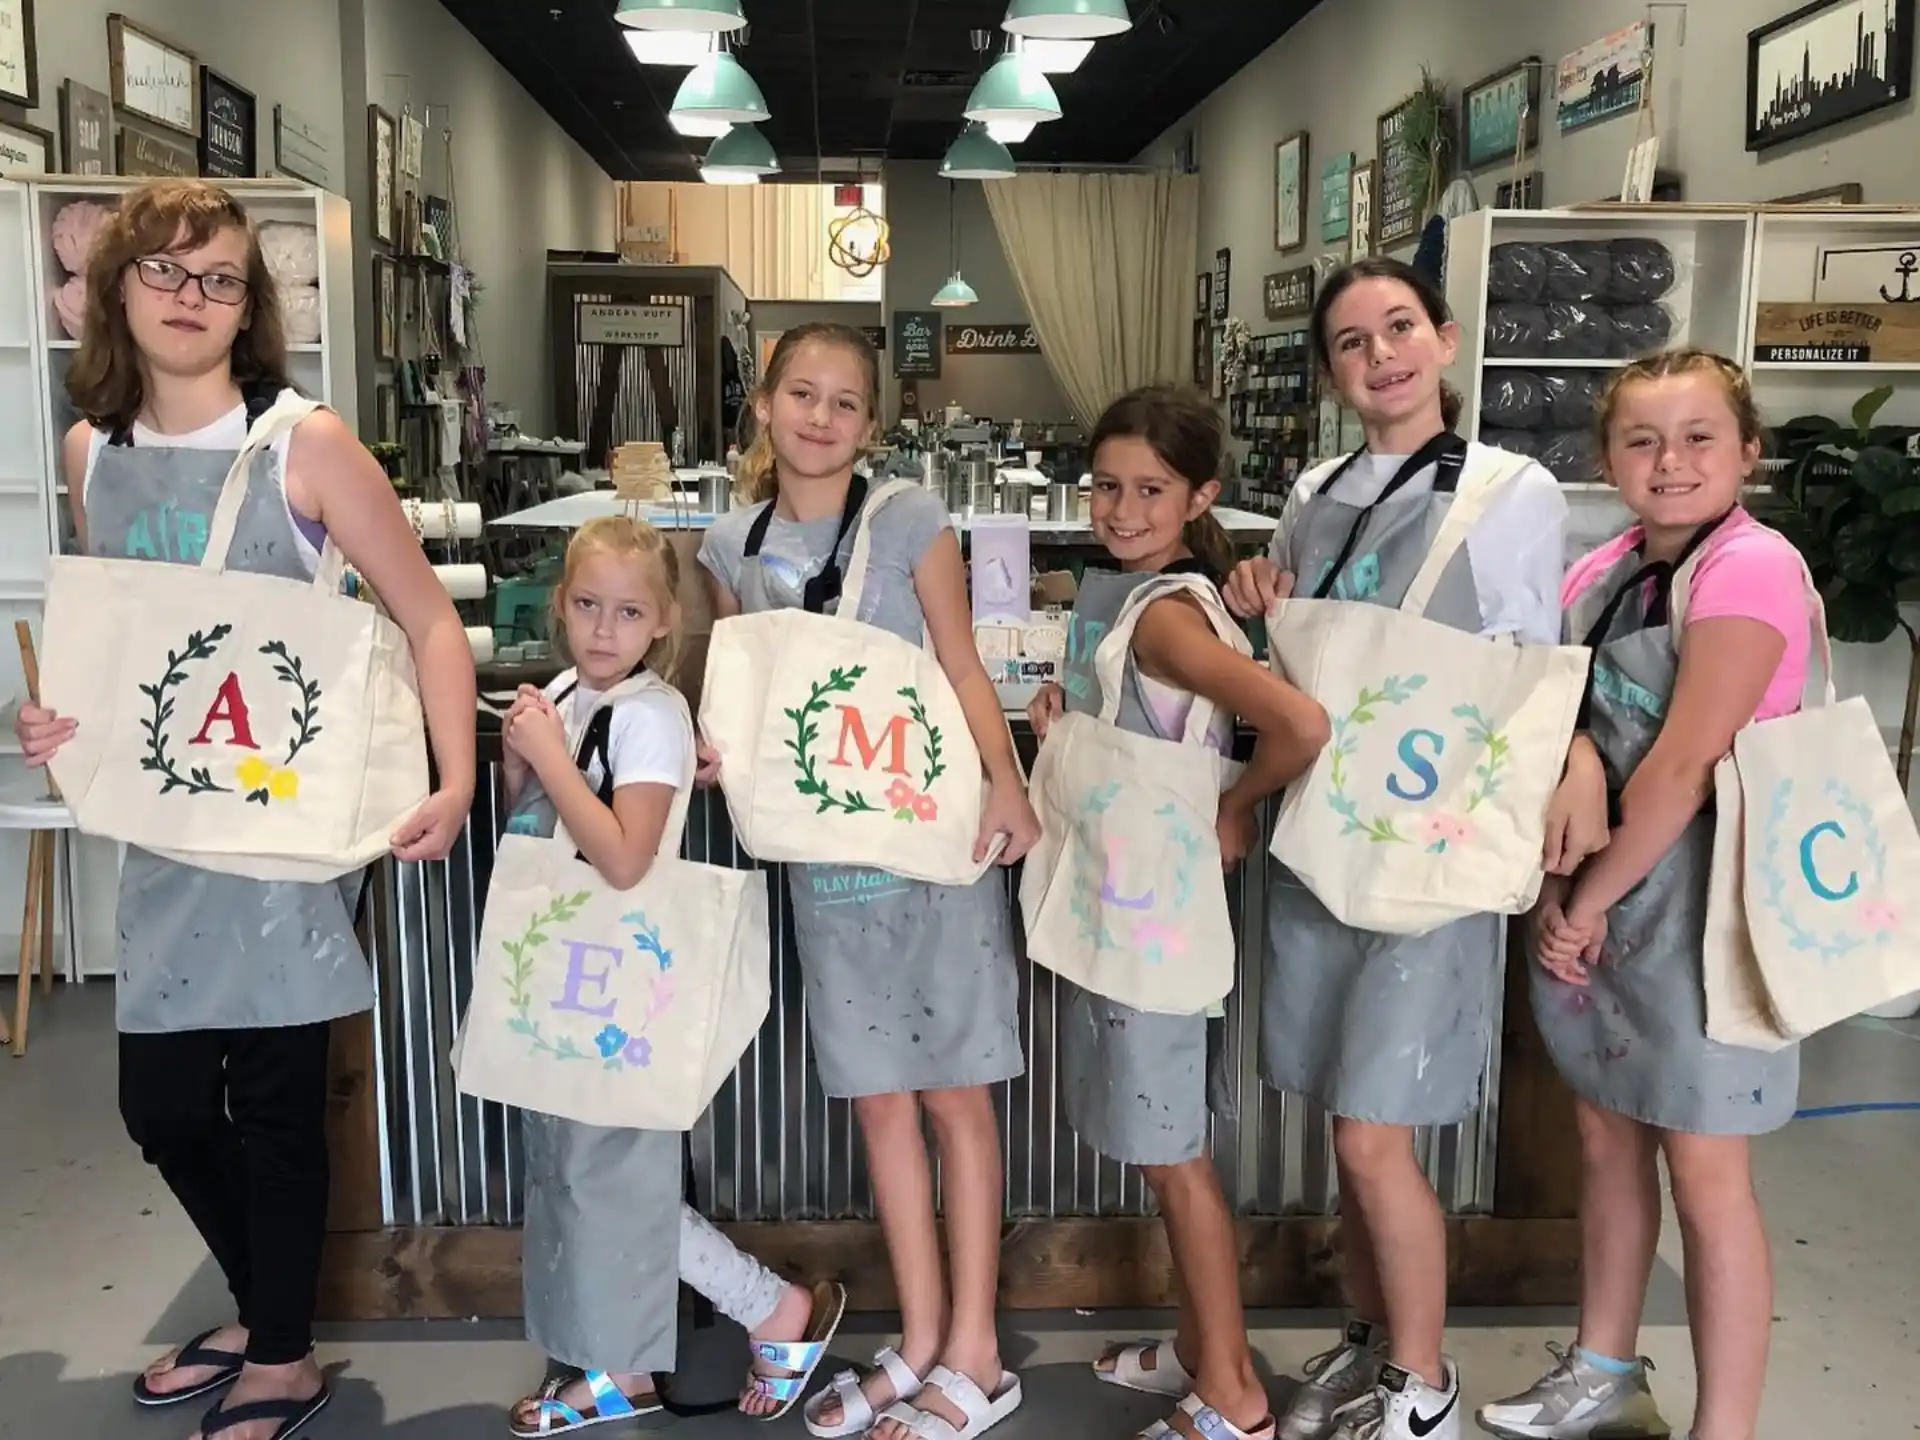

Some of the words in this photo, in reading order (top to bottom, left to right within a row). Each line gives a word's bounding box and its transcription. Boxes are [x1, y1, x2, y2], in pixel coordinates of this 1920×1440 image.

[956, 328, 1017, 349] Drink
[1770, 348, 1844, 361] PERSONALIZE
[1847, 348, 1859, 360] IT
[1799, 312, 1824, 332] LIFE
[1826, 311, 1838, 324] IS
[1839, 310, 1883, 332] BETTER
[188, 671, 261, 749] A
[828, 704, 914, 778] M
[1386, 729, 1444, 801] S
[812, 873, 849, 893] PLAY
[1100, 835, 1155, 911] L
[1800, 820, 1859, 901] C
[550, 938, 624, 1018] E
